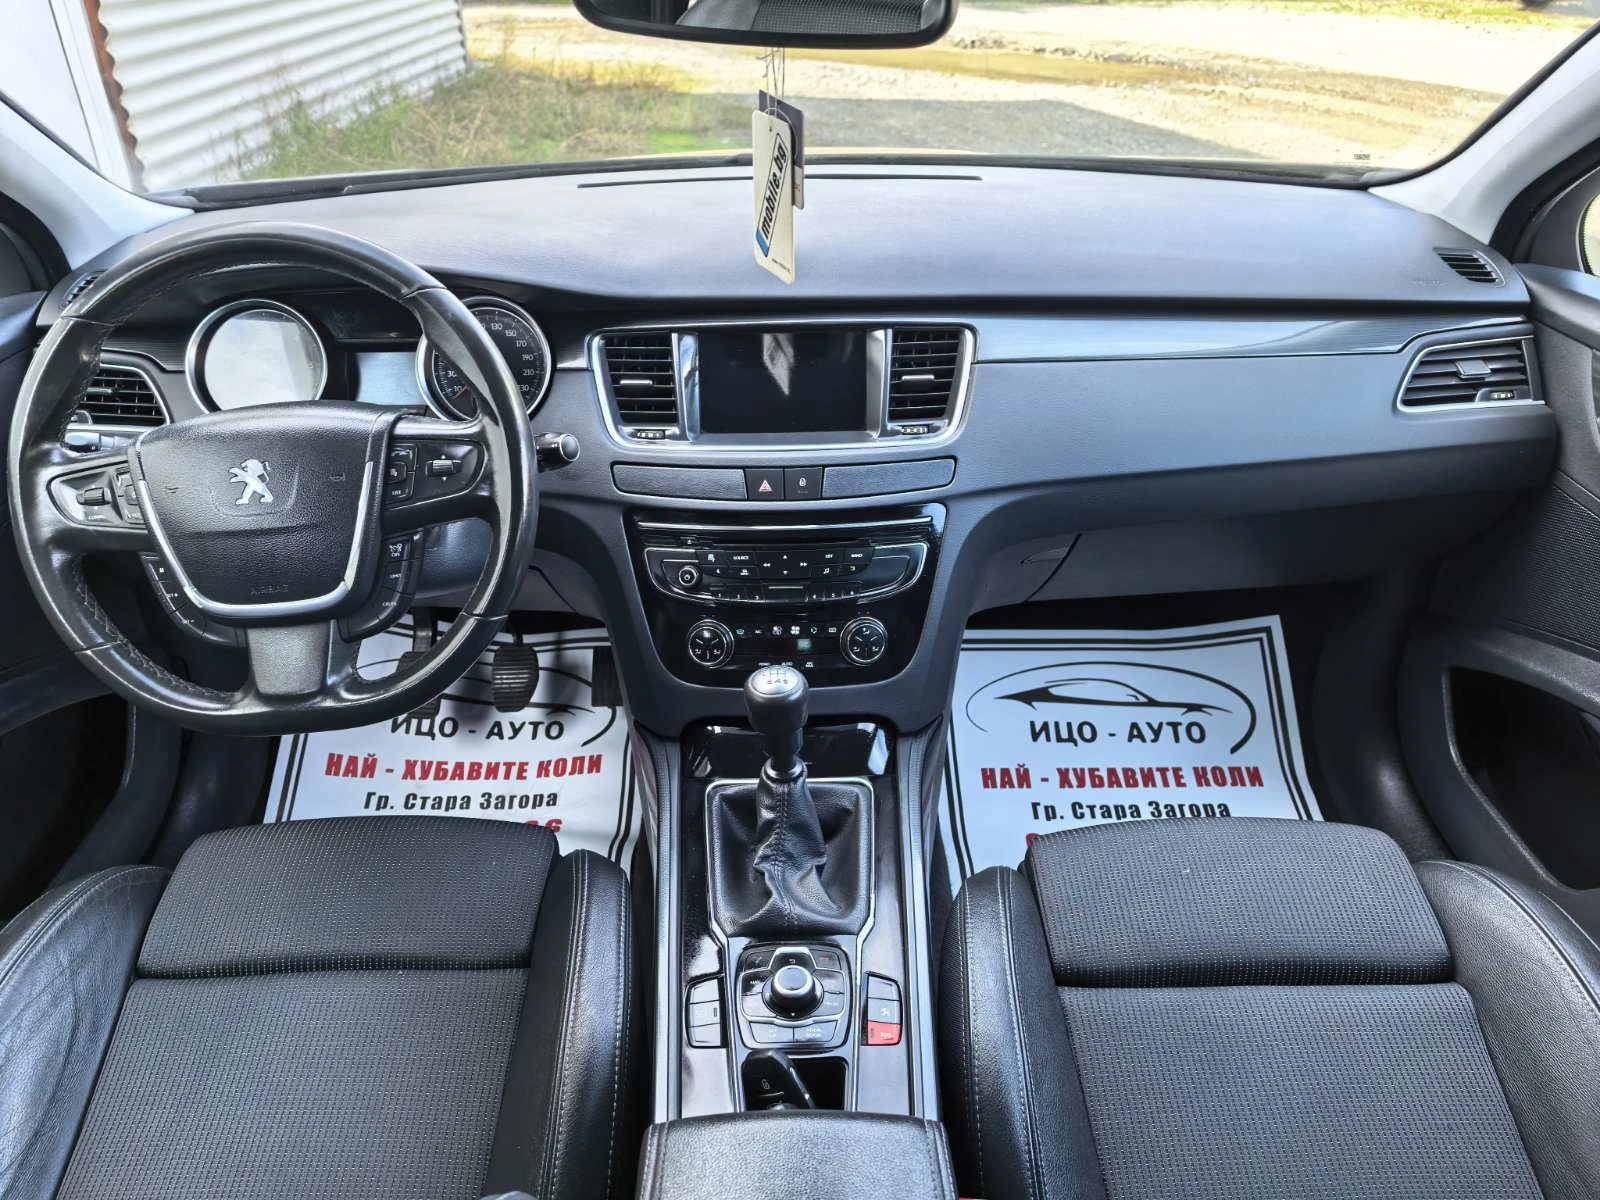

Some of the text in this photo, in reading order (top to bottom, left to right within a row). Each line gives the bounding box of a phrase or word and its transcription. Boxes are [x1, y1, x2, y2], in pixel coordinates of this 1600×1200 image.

[761, 143, 788, 240] mobile.bg
[491, 322, 503, 330] 130
[505, 329, 517, 337] 150
[516, 339, 527, 347] 170
[390, 716, 459, 741] ИЦО
[485, 720, 565, 741] АУТО
[1029, 720, 1098, 747] ИЦО
[1127, 721, 1207, 745] АУТО
[325, 752, 378, 779] НАЙ
[401, 759, 528, 781] ХУБАВИТЕ
[536, 753, 603, 779] КОЛИ
[981, 763, 1032, 789] НАЙ
[1056, 767, 1185, 789] ХУБАВИТЕ
[1194, 766, 1264, 788] КОЛИ
[364, 791, 558, 813] Гр. Стара Загора
[1031, 800, 1231, 821] Гр. Стара Загора
